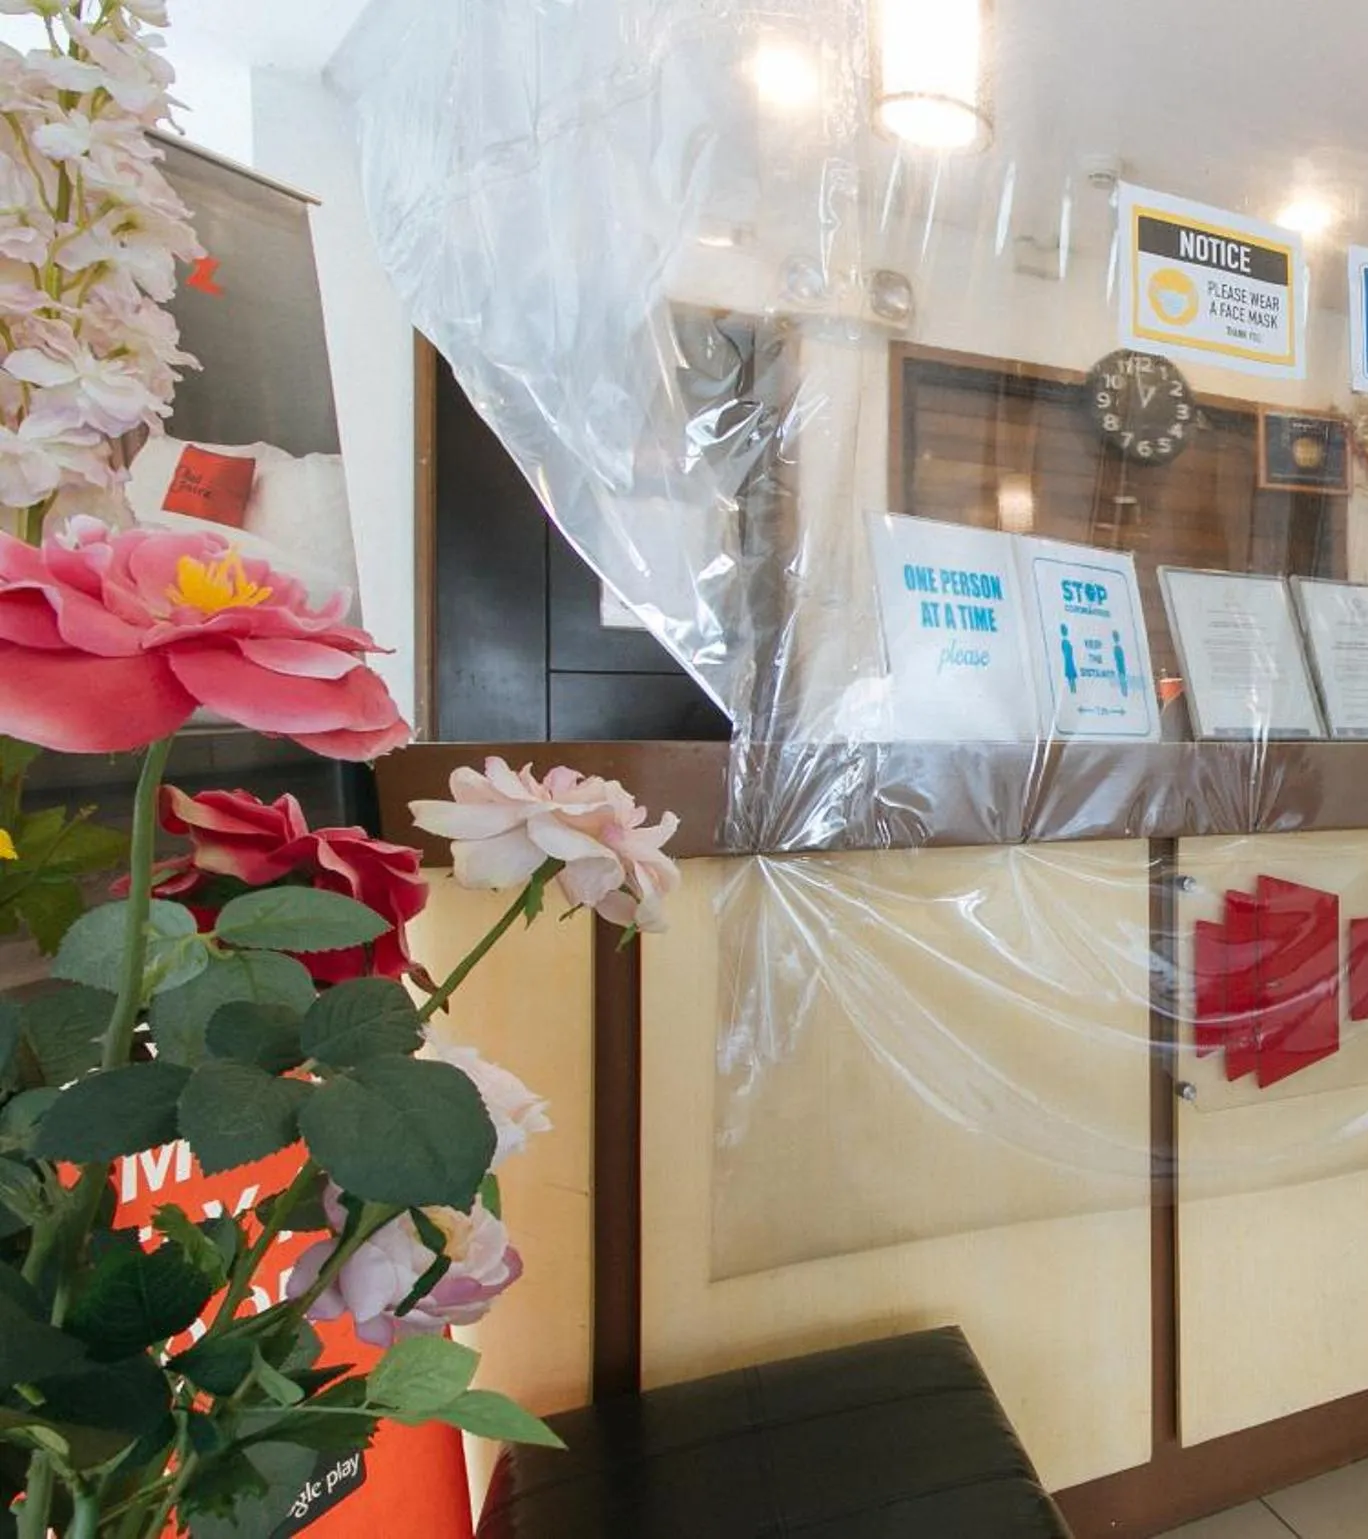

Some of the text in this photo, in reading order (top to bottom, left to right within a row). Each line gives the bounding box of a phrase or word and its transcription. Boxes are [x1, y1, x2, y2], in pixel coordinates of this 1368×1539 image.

[1180, 229, 1251, 273] NOTICE
[1207, 280, 1279, 311] PLEASE WEAR
[1210, 300, 1278, 330] A FACE MASK
[1103, 373, 1122, 390] 10
[1169, 381, 1183, 397] 2
[1097, 392, 1111, 408] 9
[1103, 413, 1119, 431] 8
[1175, 404, 1189, 420] 3
[1121, 431, 1134, 448] 7
[1167, 423, 1182, 438] 4
[1137, 440, 1153, 457] 6
[904, 564, 1004, 601] ONE PERSON
[1062, 580, 1107, 605] STOP
[921, 602, 998, 632] AT A TIME
[937, 639, 991, 674] please
[325, 1452, 360, 1494] play
